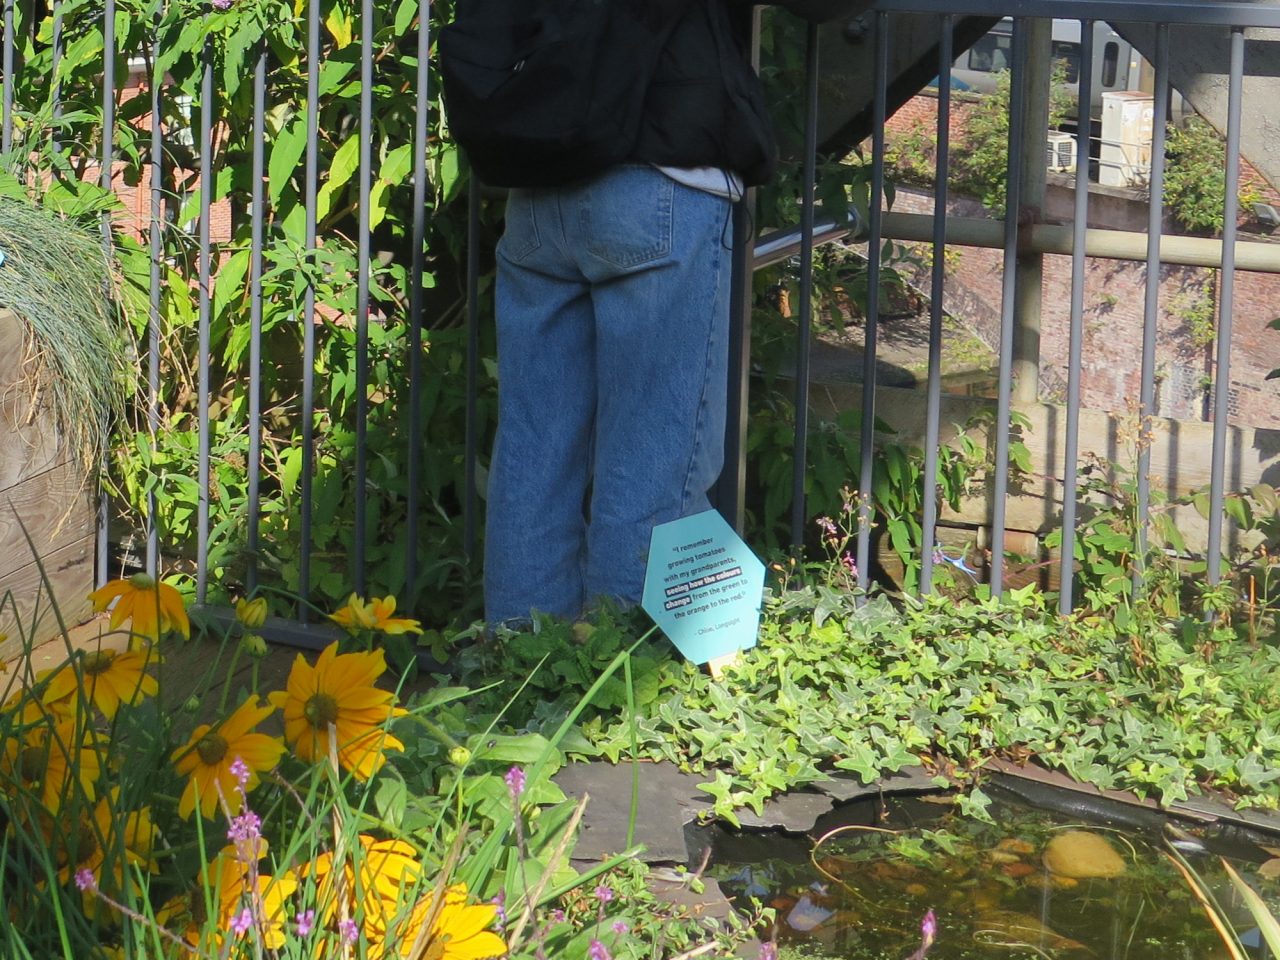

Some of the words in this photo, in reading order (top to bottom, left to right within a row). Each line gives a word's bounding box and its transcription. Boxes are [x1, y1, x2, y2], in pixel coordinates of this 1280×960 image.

[680, 537, 713, 552] remember
[668, 555, 695, 570] growing
[695, 547, 726, 560] tomatoes
[664, 572, 679, 583] with
[680, 569, 690, 578] my
[666, 584, 689, 596] seeing
[689, 579, 704, 589] how
[704, 576, 716, 584] the
[716, 567, 741, 581] colours
[665, 597, 691, 609] change
[692, 591, 709, 600] from
[709, 586, 721, 594] the
[721, 582, 741, 592] green
[674, 611, 686, 620] the
[687, 604, 710, 616] orange
[718, 597, 730, 605] the
